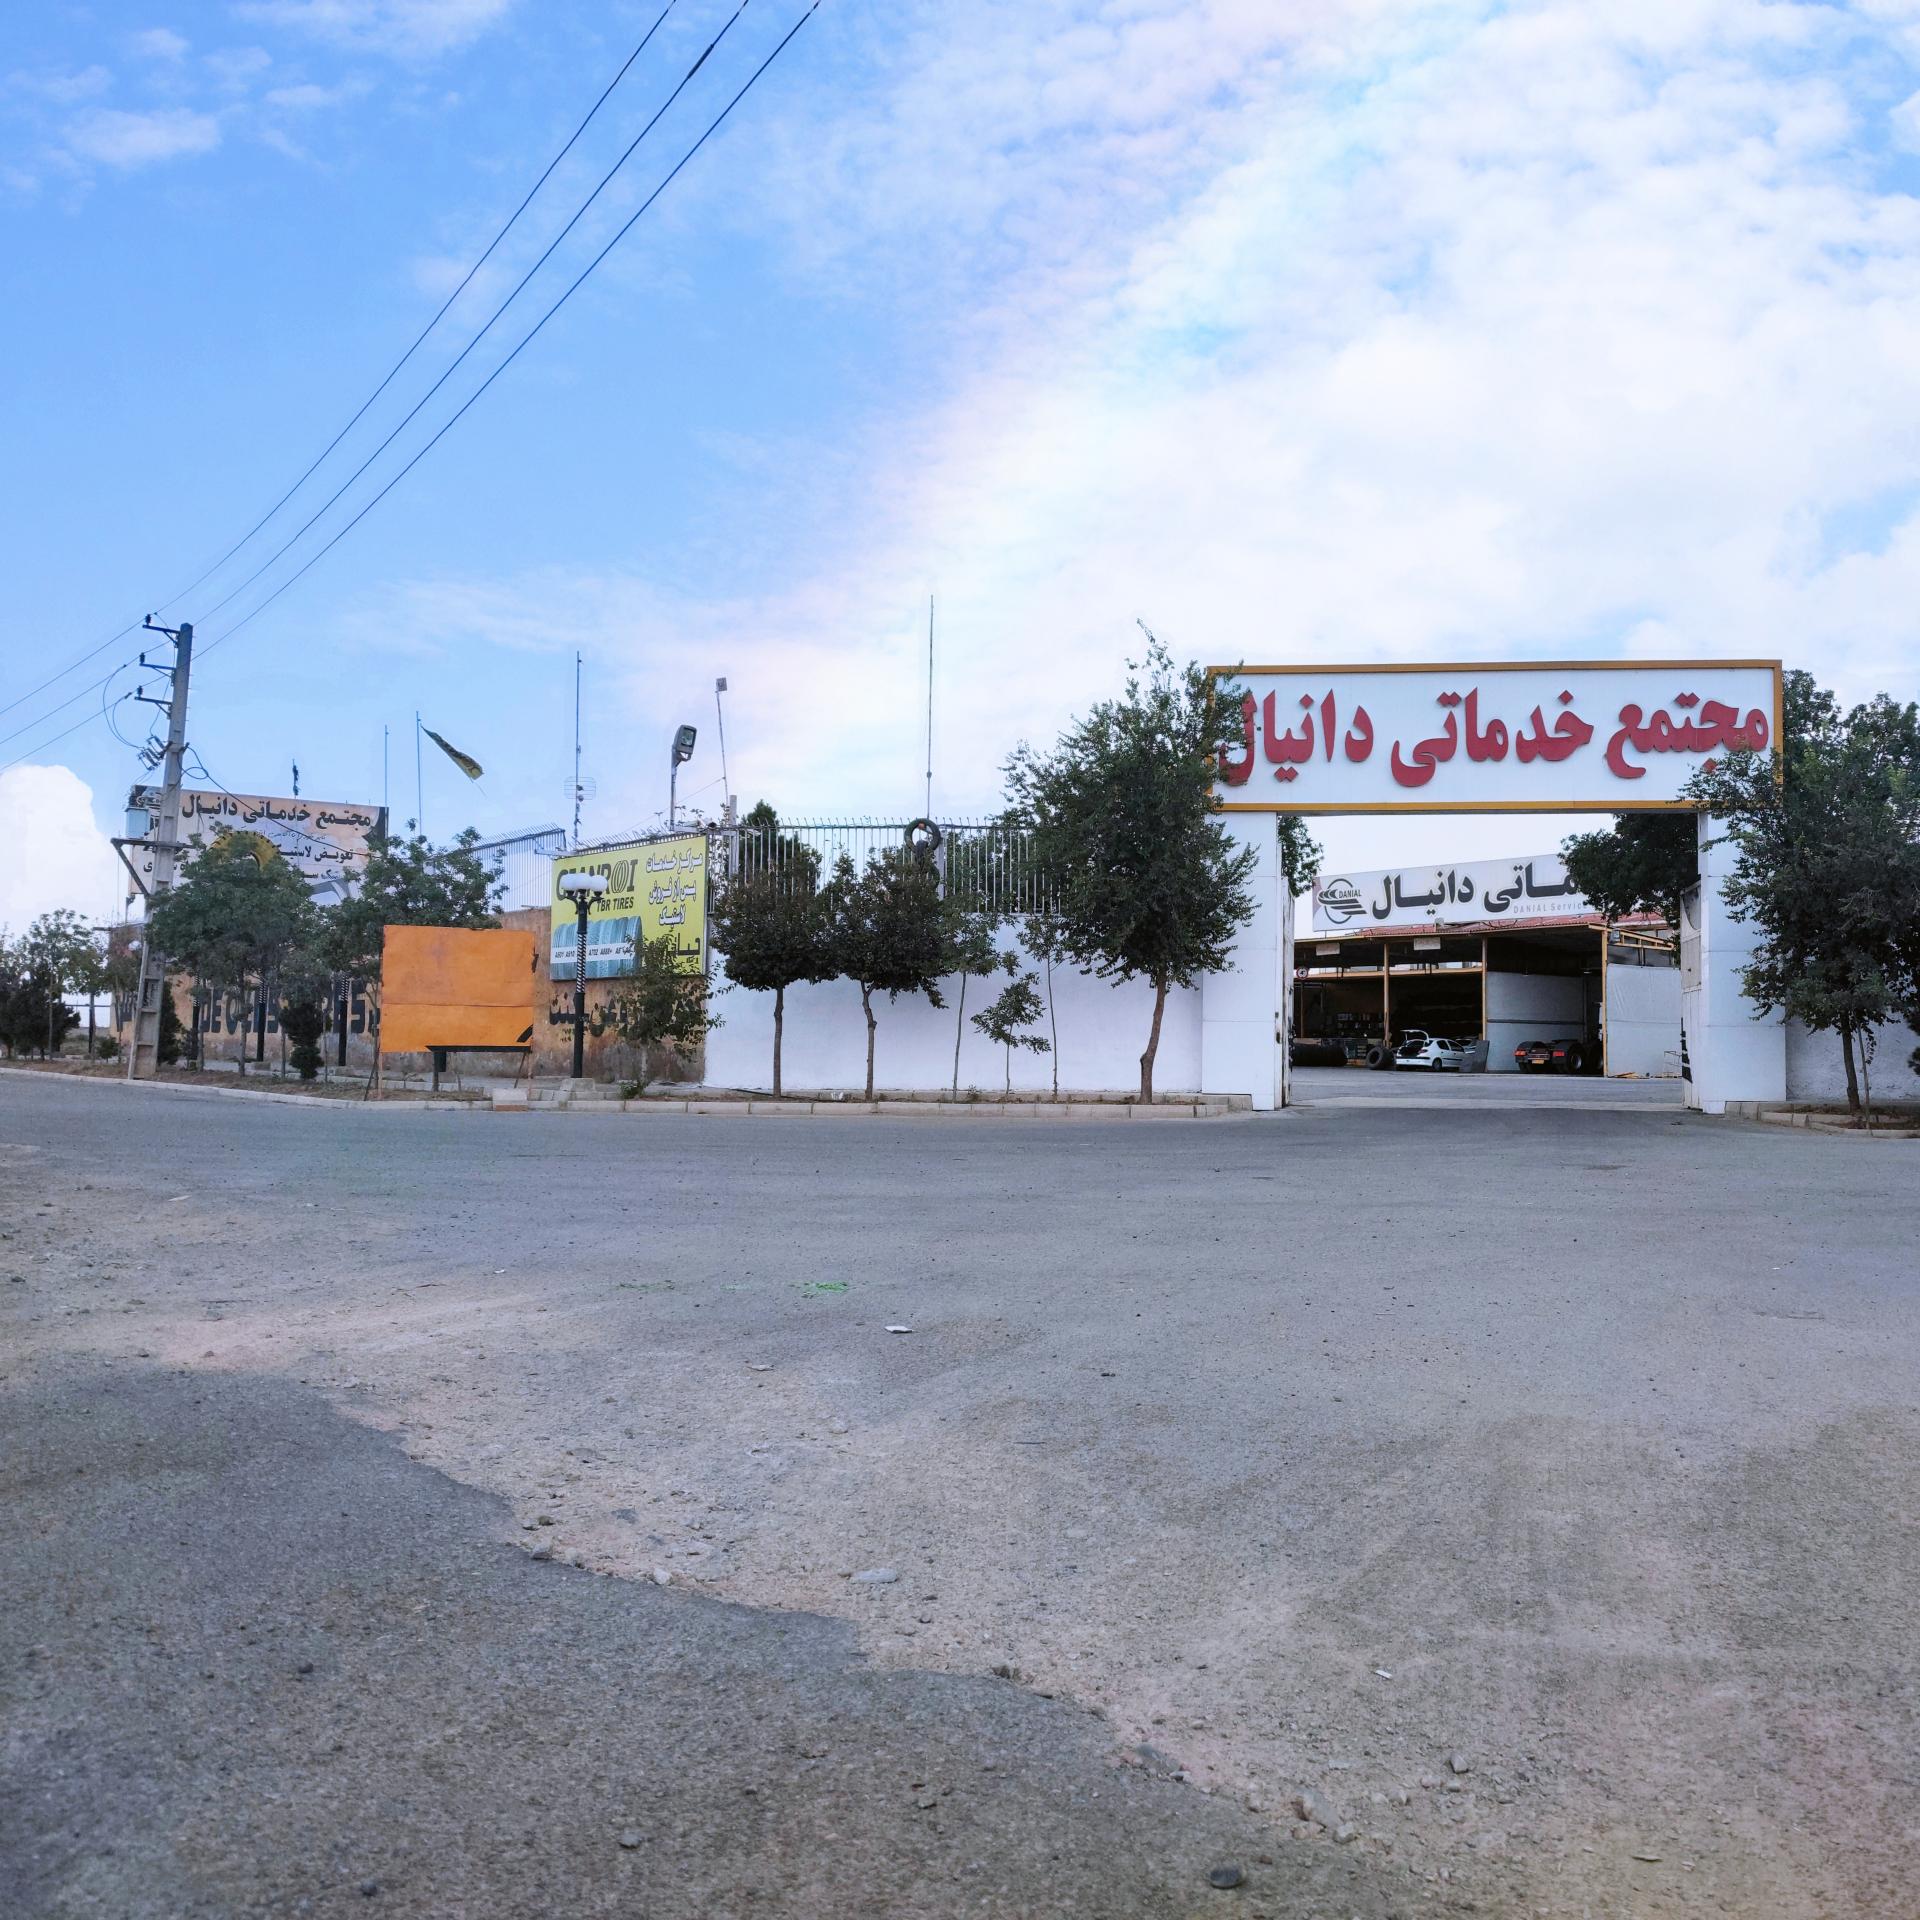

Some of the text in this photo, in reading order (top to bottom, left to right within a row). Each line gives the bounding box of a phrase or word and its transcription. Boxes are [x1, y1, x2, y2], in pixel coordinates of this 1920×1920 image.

[1218, 687, 1769, 787] مجتمع خدماتی دانیال
[182, 794, 371, 831] مجتمع خدماتی دانیال
[596, 896, 634, 912] TBR TIRES
[1338, 889, 1362, 899] DANIAL
[1372, 869, 1475, 920] دانیال
[1513, 903, 1547, 914] DANIAL
